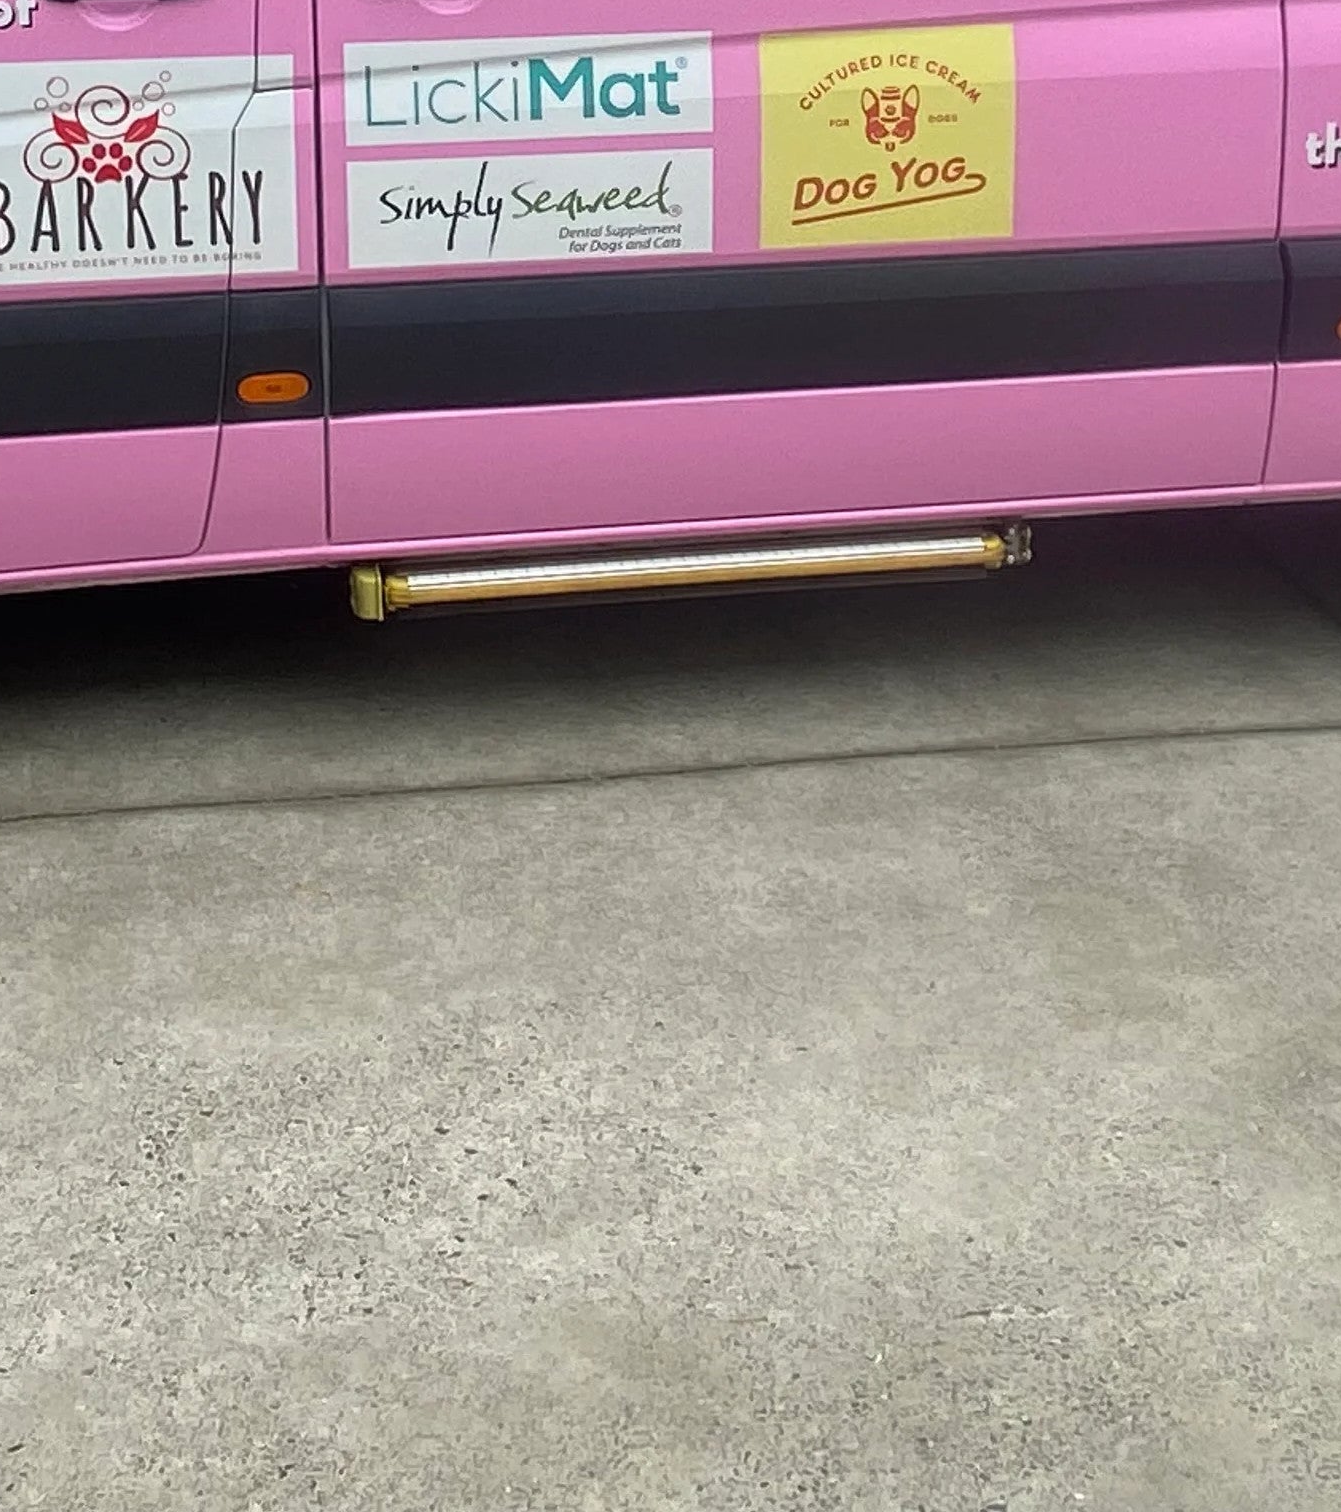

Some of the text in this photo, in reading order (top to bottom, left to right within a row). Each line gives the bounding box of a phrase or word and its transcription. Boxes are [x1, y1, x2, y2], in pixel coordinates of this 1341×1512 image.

[799, 54, 982, 111] CULTURED ICE CREAM
[794, 156, 966, 211] DOG YOG
[380, 161, 503, 258] Simply
[558, 223, 682, 240] Dental Supplement
[569, 236, 682, 254] for Dogs and Cats
[9, 260, 68, 271] HEALTHY
[133, 255, 167, 265] NEED
[172, 254, 188, 264] TO
[192, 254, 207, 263] BE
